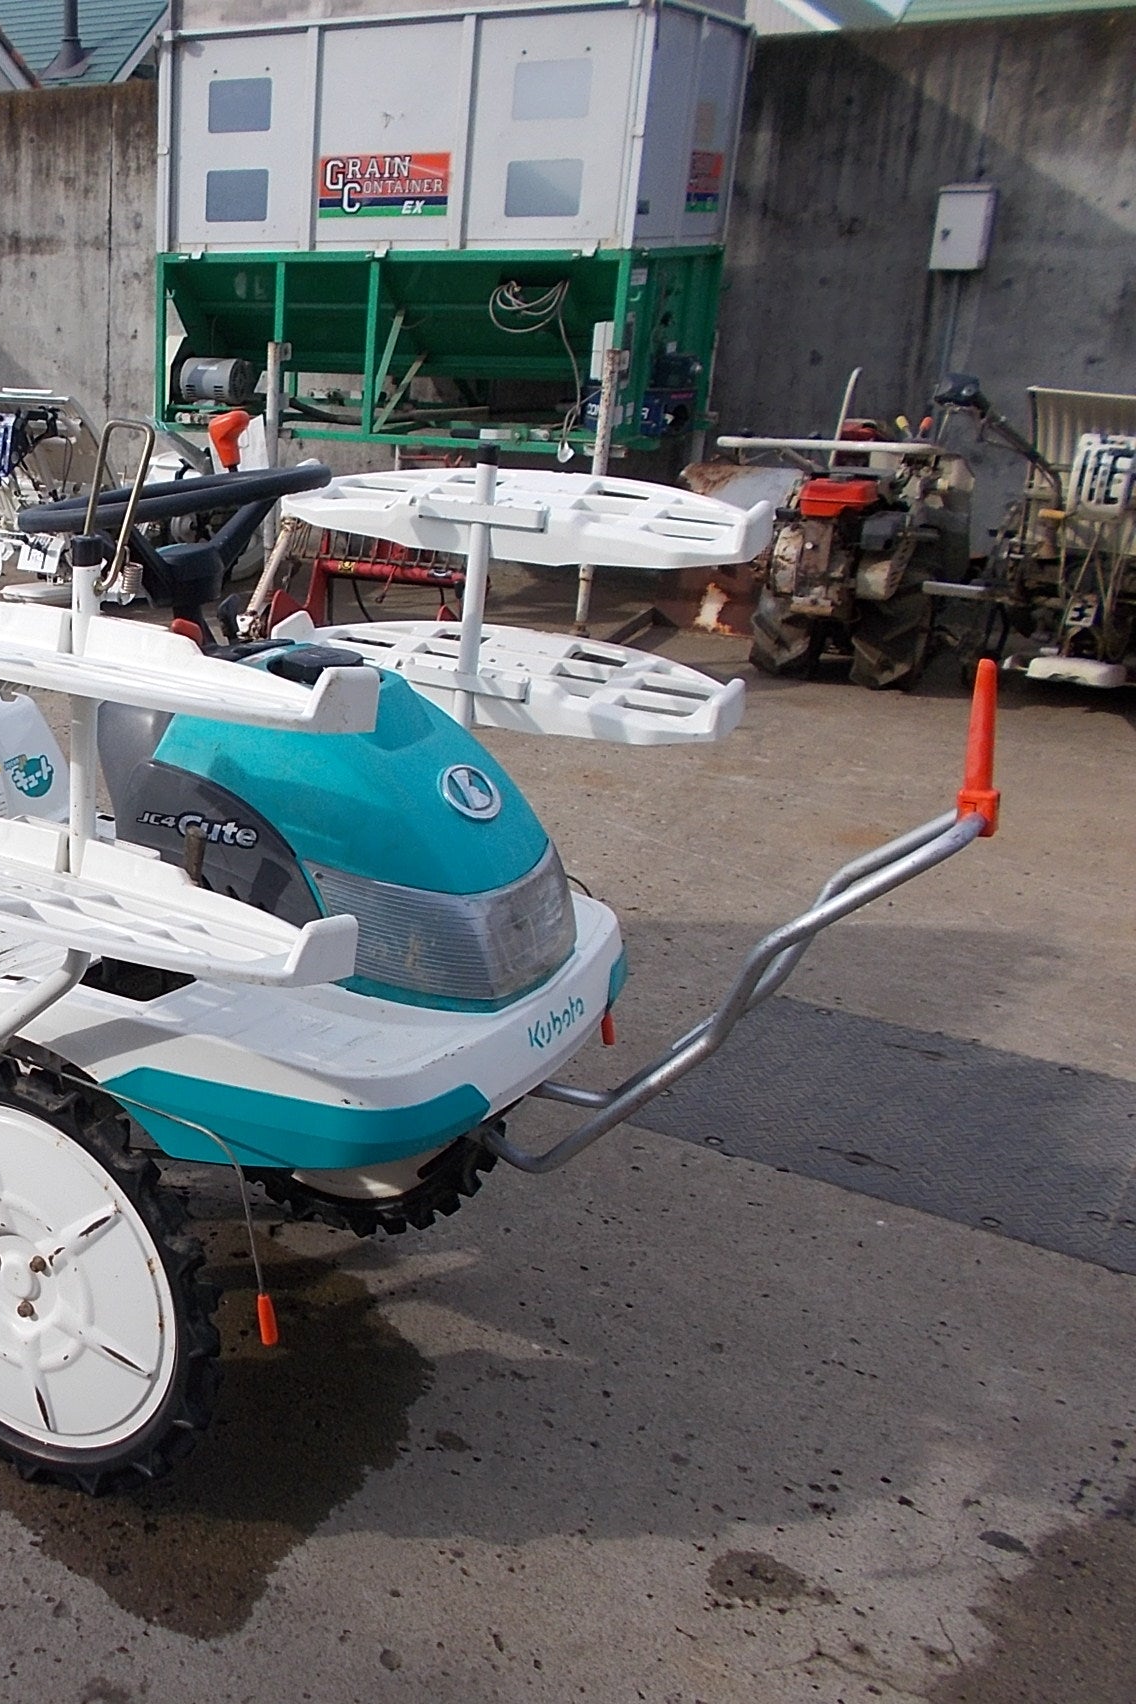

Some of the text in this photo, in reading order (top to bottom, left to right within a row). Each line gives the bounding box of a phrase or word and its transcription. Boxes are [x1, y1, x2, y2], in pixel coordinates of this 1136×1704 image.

[325, 155, 411, 190] GRAIN
[343, 179, 444, 213] CONTAINER
[401, 199, 425, 214] EX
[13, 756, 52, 791] キュート
[137, 811, 258, 848] JC4 Cute
[527, 995, 584, 1049] Kubota
